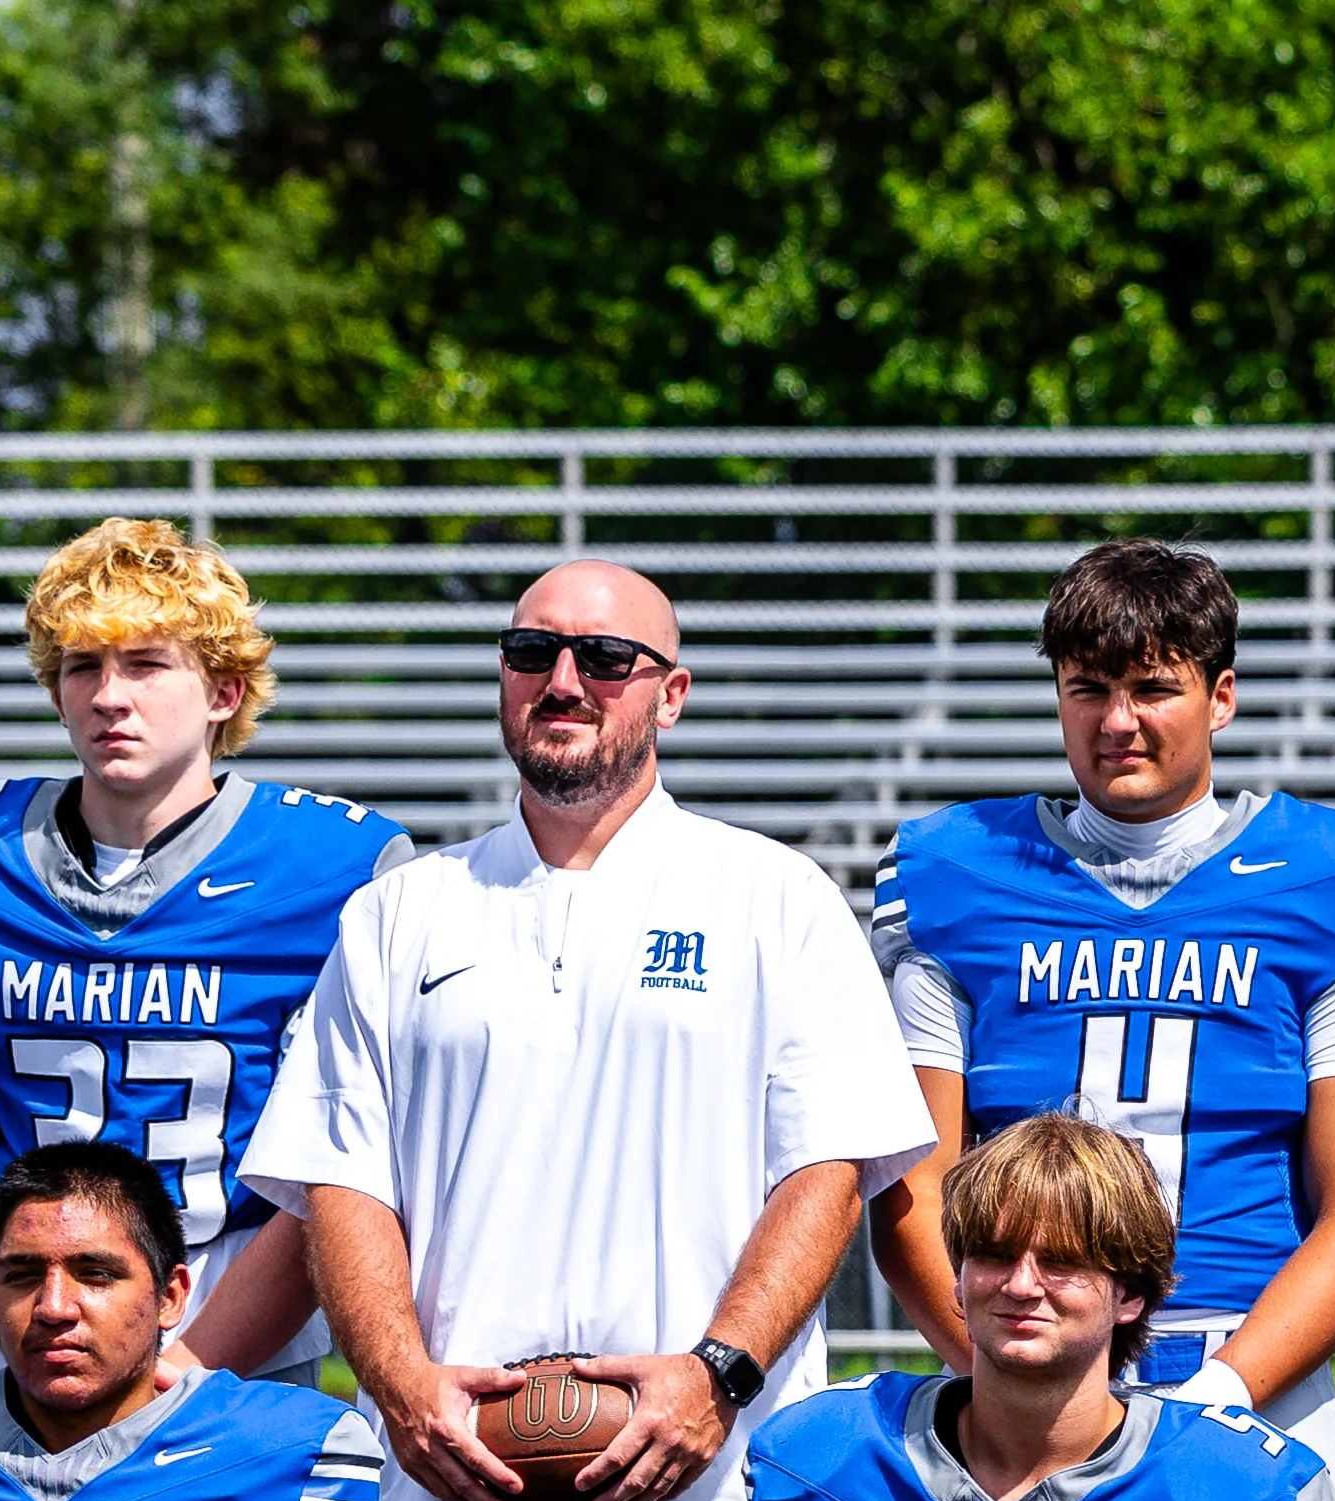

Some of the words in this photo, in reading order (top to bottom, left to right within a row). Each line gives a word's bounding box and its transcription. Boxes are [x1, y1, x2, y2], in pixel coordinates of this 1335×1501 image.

[641, 976, 708, 993] FOOTBALL
[642, 929, 709, 976] M
[1018, 938, 1260, 1008] MARIAN
[1, 959, 222, 1025] MARIAN
[1077, 1014, 1199, 1230] 4
